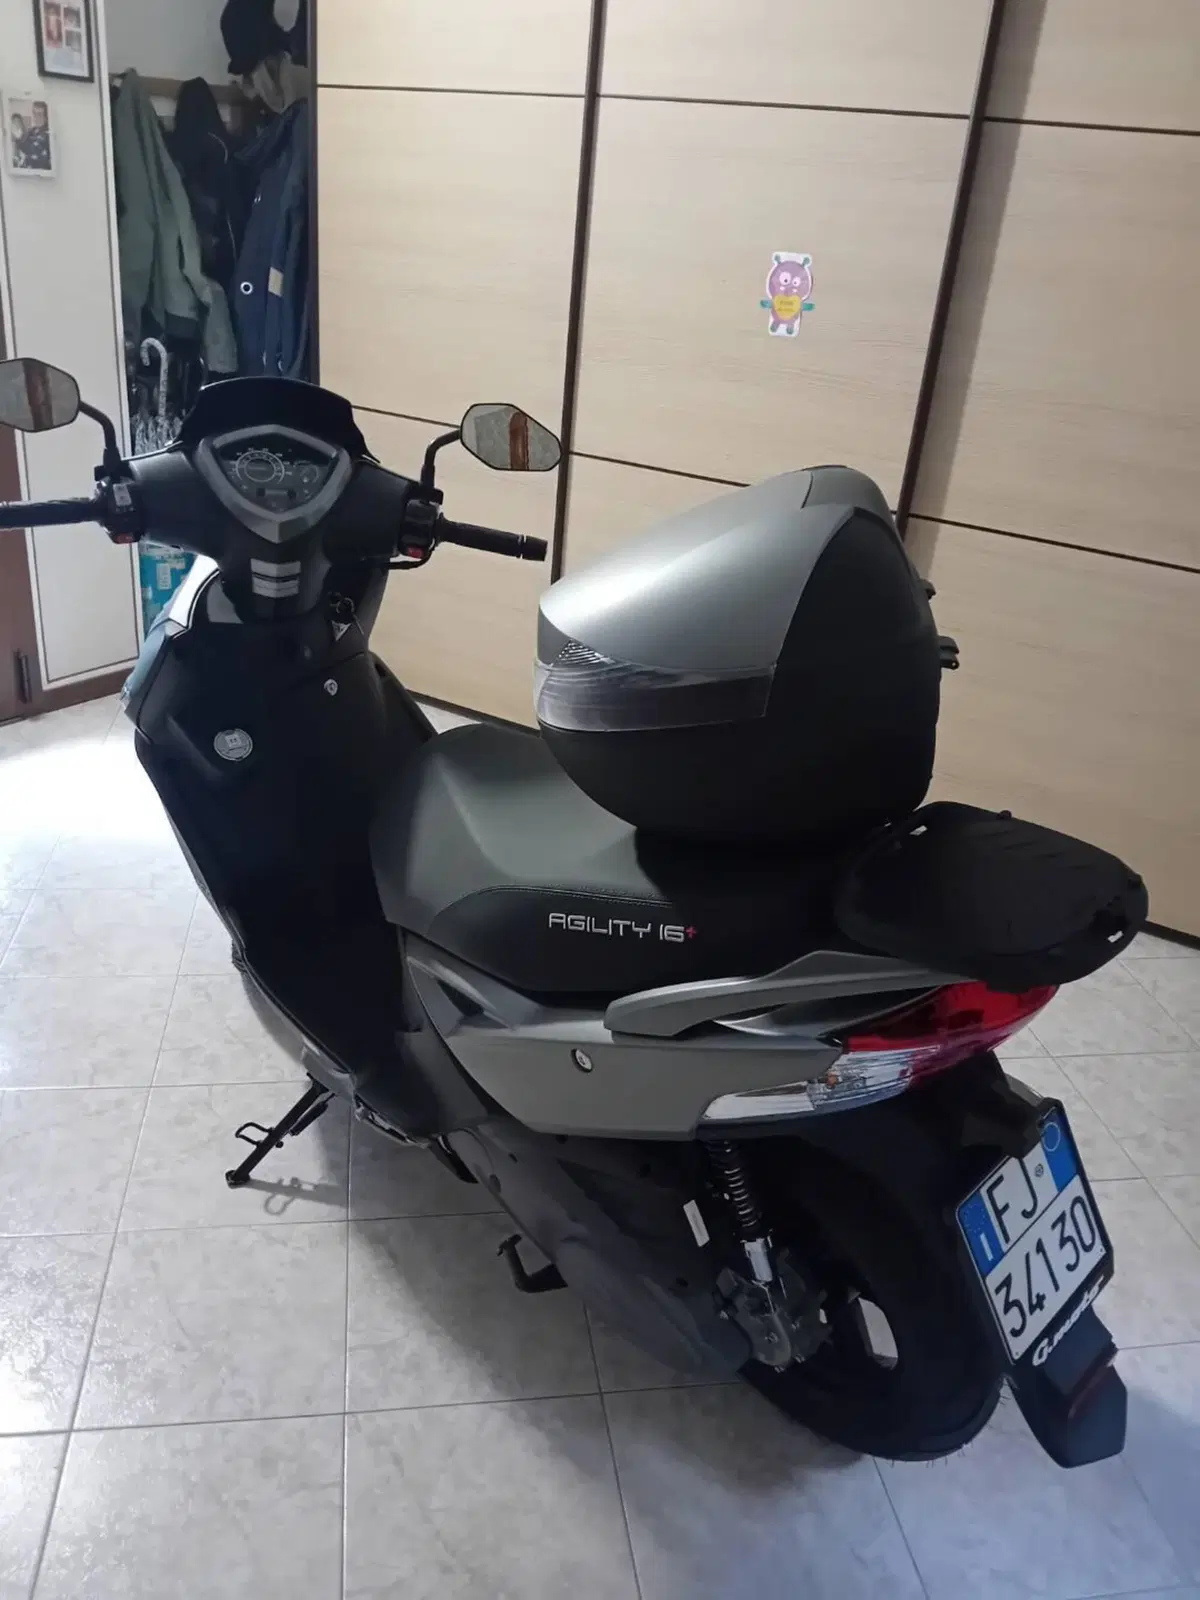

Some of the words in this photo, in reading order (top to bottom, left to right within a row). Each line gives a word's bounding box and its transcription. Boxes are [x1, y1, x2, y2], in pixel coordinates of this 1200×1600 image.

[548, 912, 652, 938] AGILITY
[986, 1157, 1039, 1244] FJ
[994, 1195, 1096, 1339] 34130
